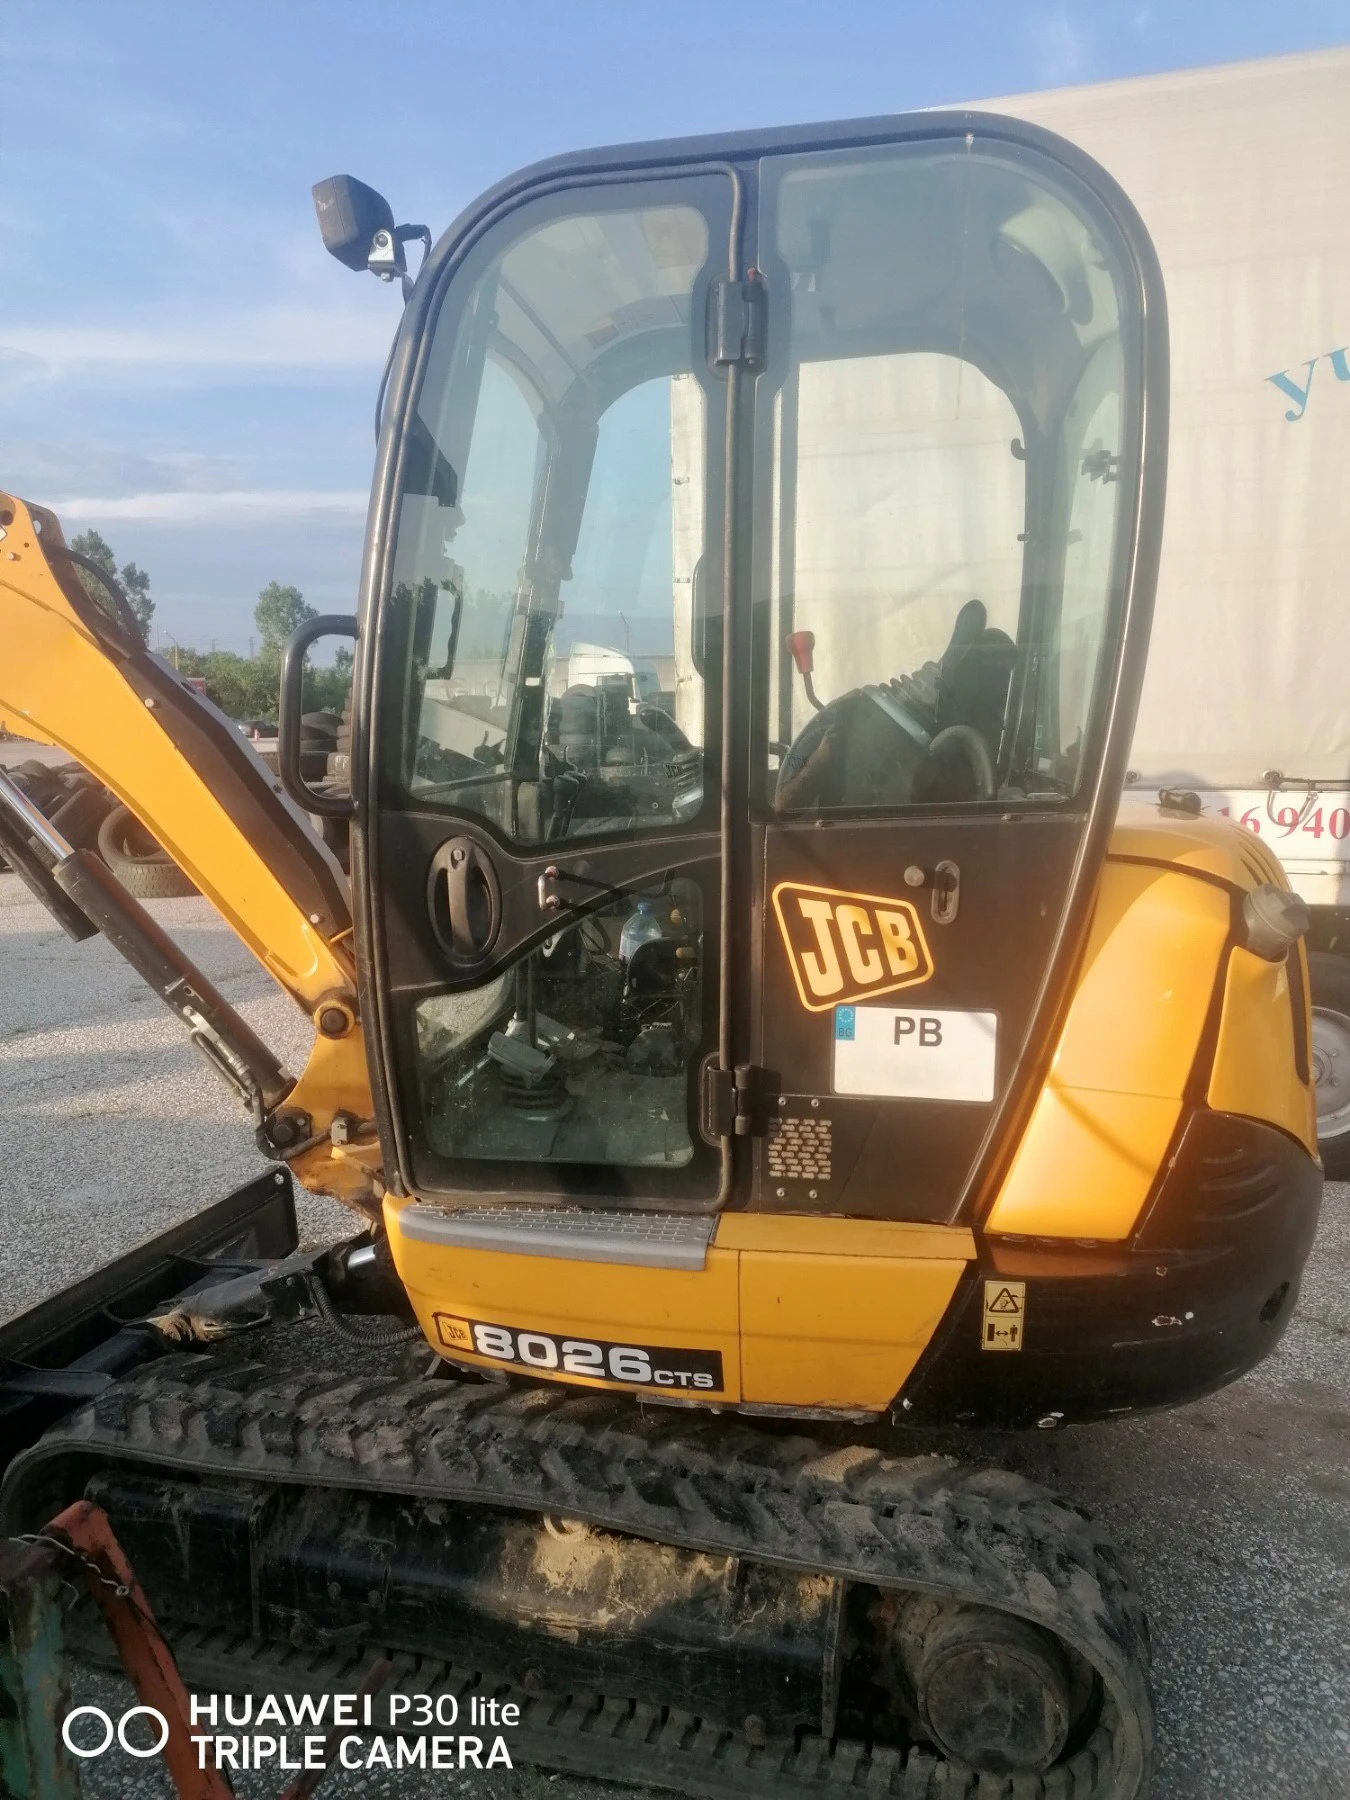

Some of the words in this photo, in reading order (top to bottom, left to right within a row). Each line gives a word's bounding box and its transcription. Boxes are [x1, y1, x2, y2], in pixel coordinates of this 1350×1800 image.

[798, 898, 919, 997] JCB
[838, 1027, 852, 1038] BG
[894, 1016, 943, 1047] PB
[446, 1324, 467, 1339] JCB
[473, 1324, 651, 1382] 8026
[653, 1370, 714, 1388] CTS
